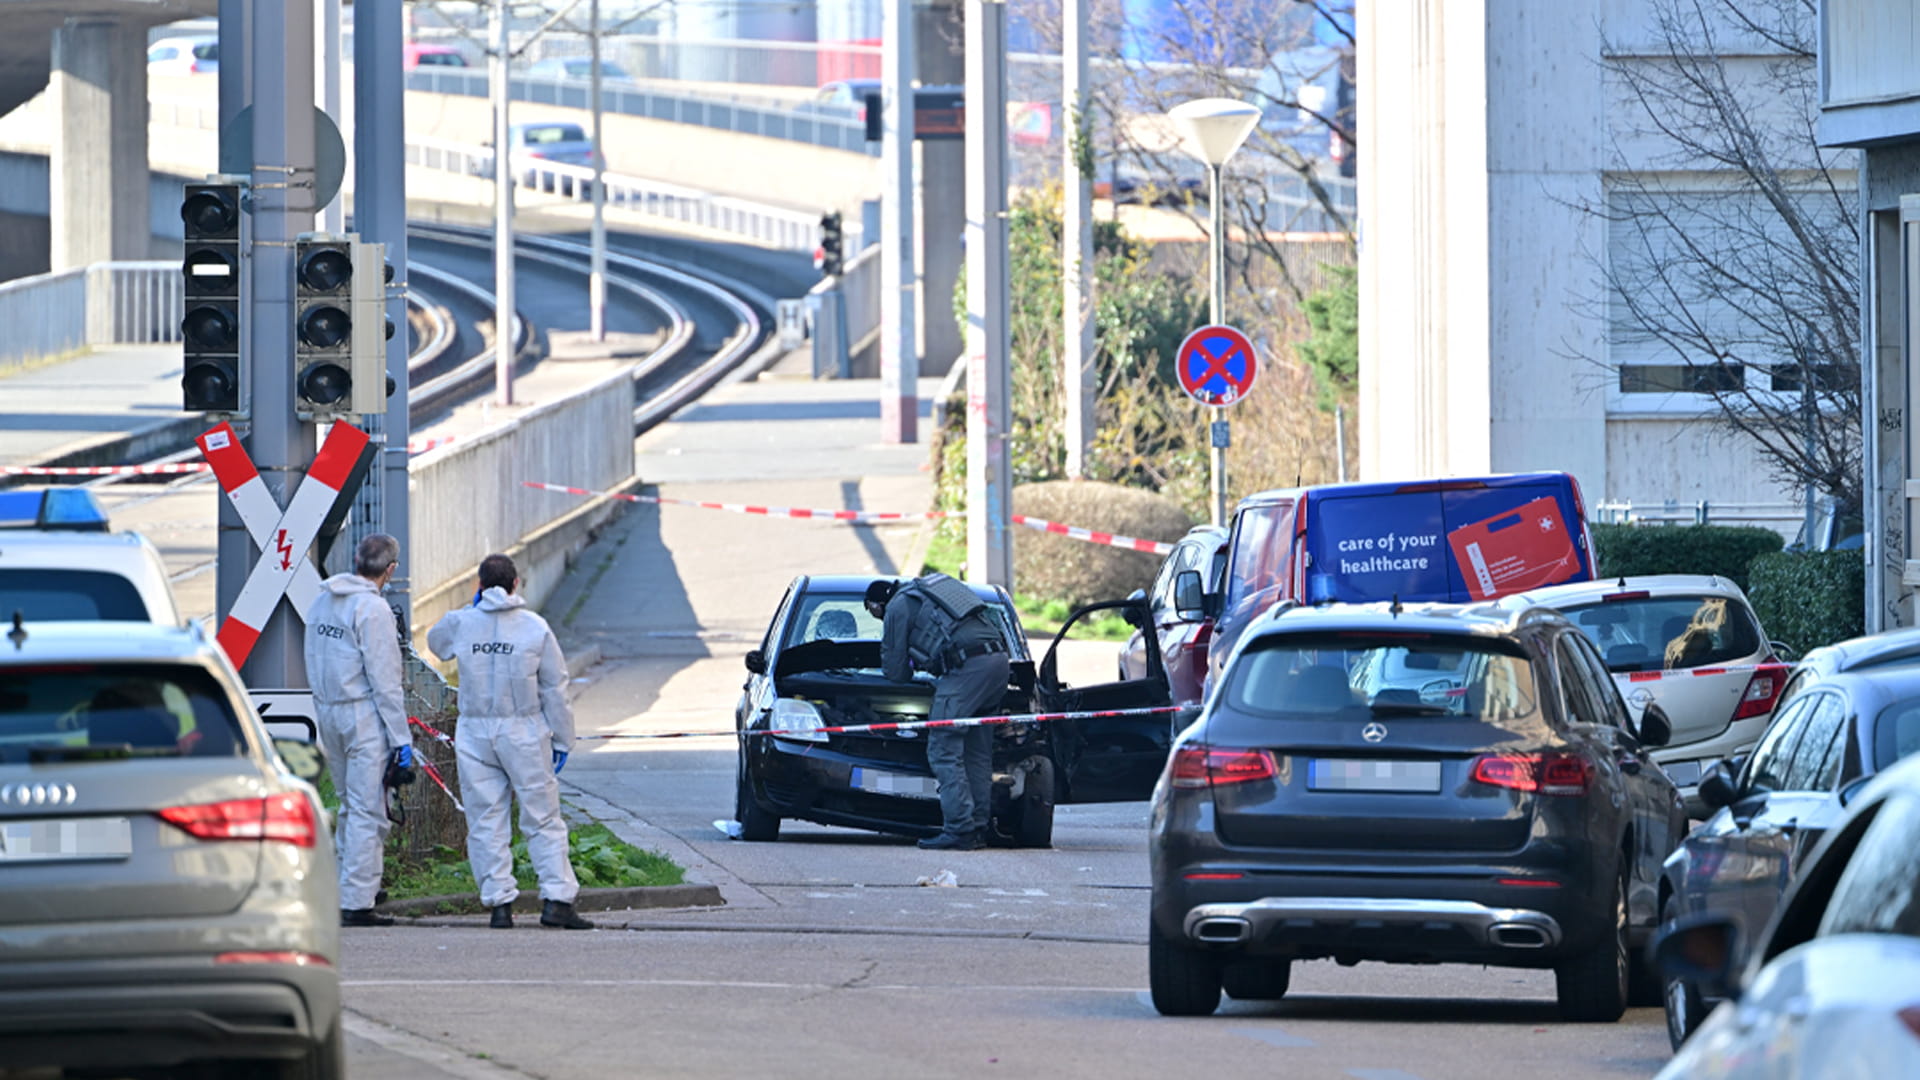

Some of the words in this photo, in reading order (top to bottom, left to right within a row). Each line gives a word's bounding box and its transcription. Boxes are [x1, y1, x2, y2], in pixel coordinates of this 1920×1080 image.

[1338, 538, 1374, 552] care
[1377, 532, 1395, 552] of
[1399, 534, 1437, 552] your
[1340, 554, 1429, 574] healthcare
